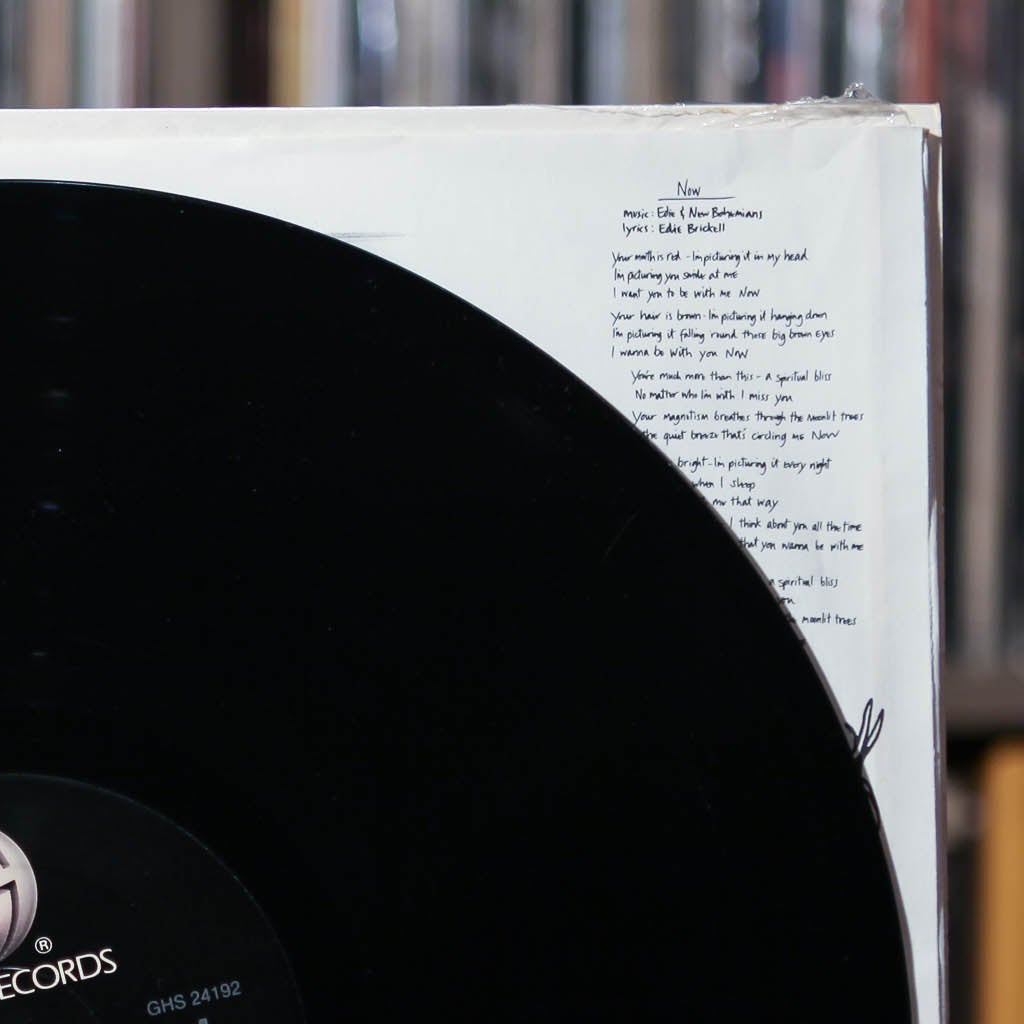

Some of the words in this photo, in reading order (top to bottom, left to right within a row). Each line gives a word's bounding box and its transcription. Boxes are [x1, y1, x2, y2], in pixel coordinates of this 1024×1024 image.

[678, 180, 700, 196] Now
[688, 222, 725, 234] Brickell
[146, 994, 187, 1017] GHS
[189, 980, 243, 1007] 24192
